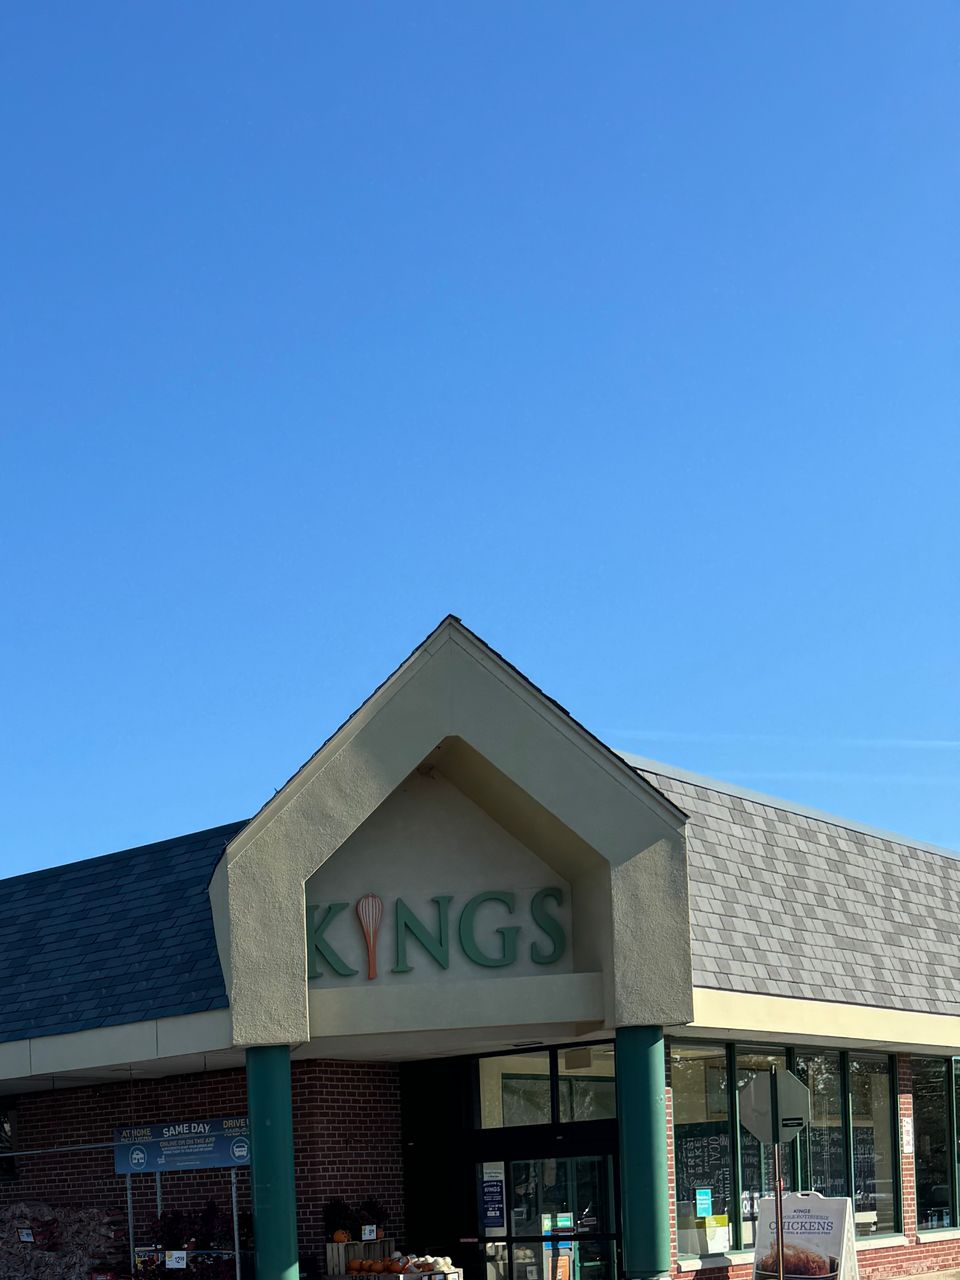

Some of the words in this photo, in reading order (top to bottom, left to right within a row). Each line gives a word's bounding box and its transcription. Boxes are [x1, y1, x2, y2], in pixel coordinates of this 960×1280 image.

[162, 1123, 189, 1137] SAME
[191, 1123, 212, 1133] DAY
[223, 1118, 246, 1128] DRIVE
[687, 1137, 695, 1173] FRES
